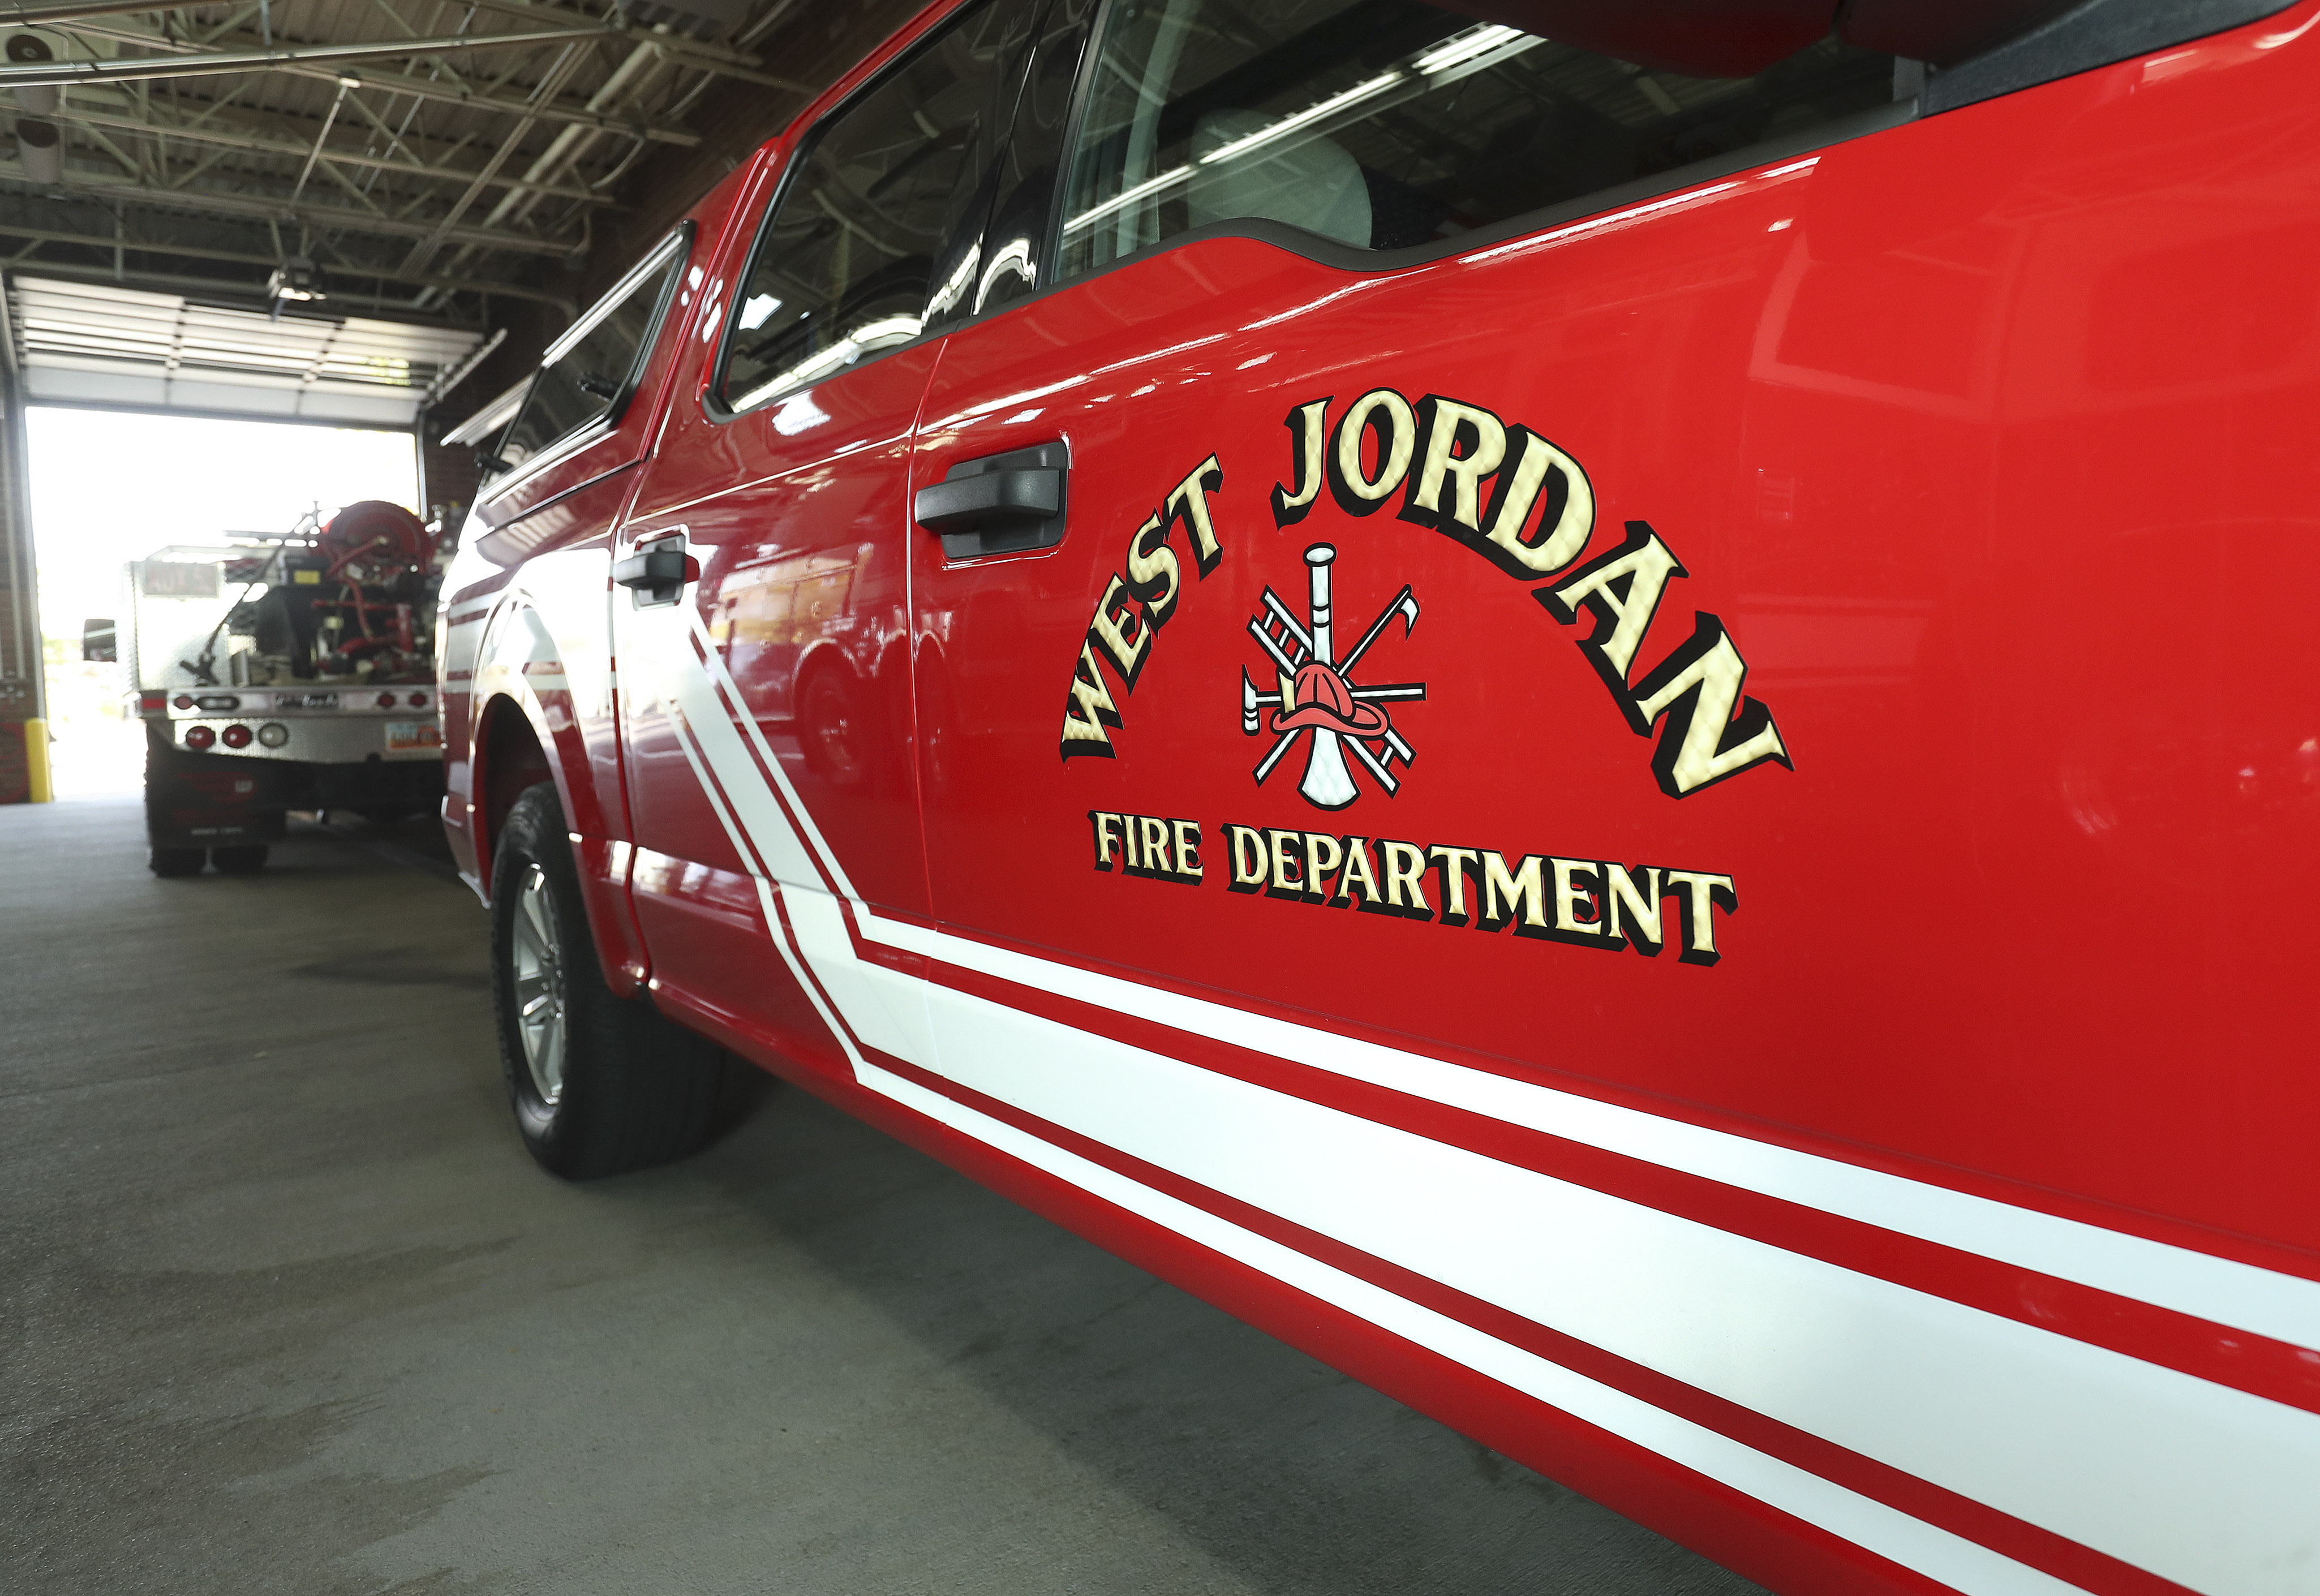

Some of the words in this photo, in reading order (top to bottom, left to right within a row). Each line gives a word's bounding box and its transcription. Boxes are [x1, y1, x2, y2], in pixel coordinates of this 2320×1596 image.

[1060, 452, 1223, 763] WEST
[1271, 387, 1795, 800] JORDAN
[1087, 810, 1204, 887] FIRE
[1221, 823, 1739, 967] DEPARTMENT
